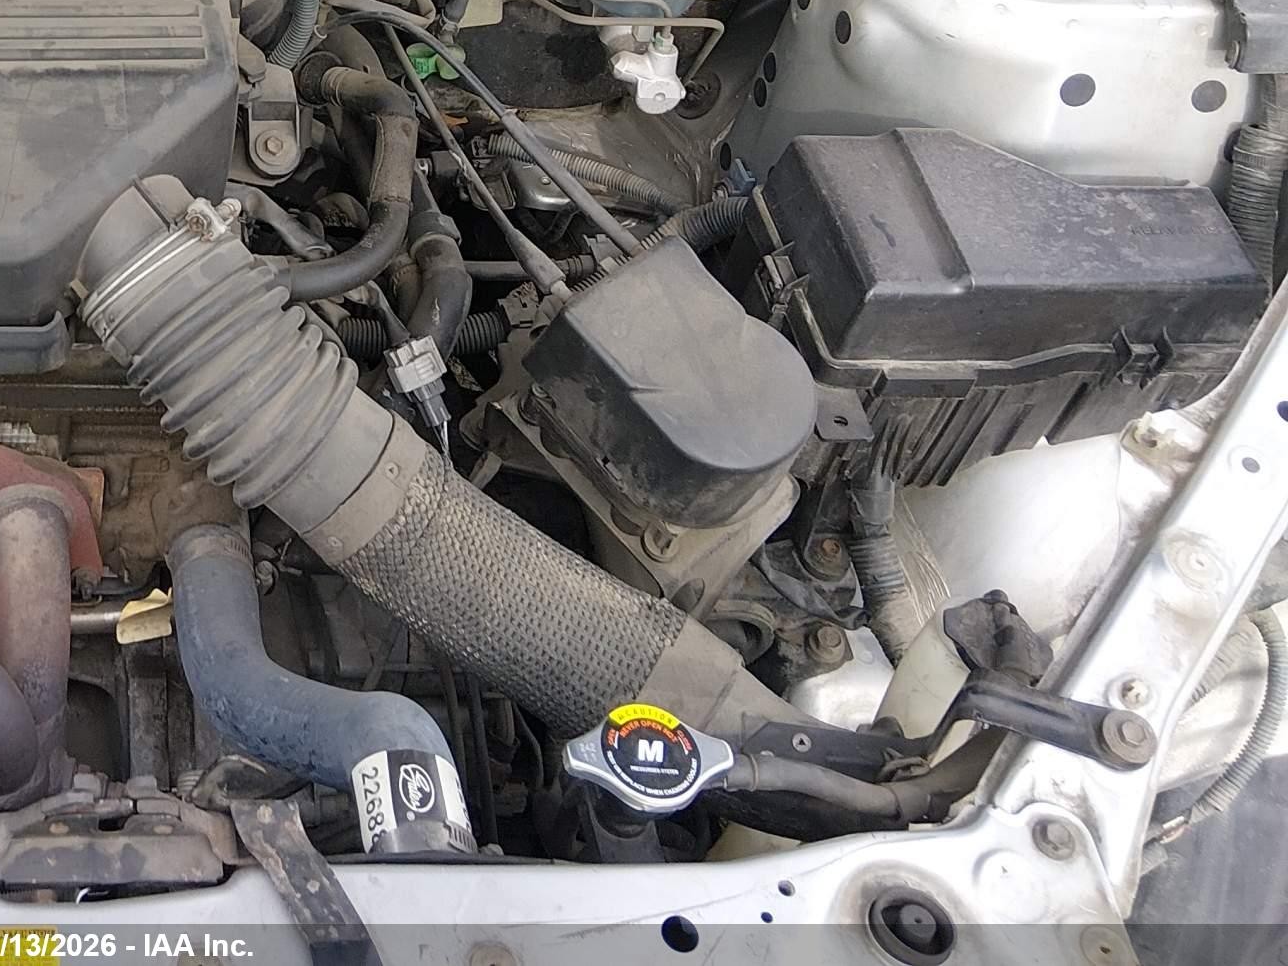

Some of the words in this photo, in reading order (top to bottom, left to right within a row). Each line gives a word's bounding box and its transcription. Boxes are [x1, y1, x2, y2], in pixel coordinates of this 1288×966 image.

[624, 708, 674, 724] CAUTION
[619, 720, 640, 738] NEVER
[640, 720, 662, 731] OPEN
[662, 727, 679, 743] HOT
[638, 738, 664, 763] M
